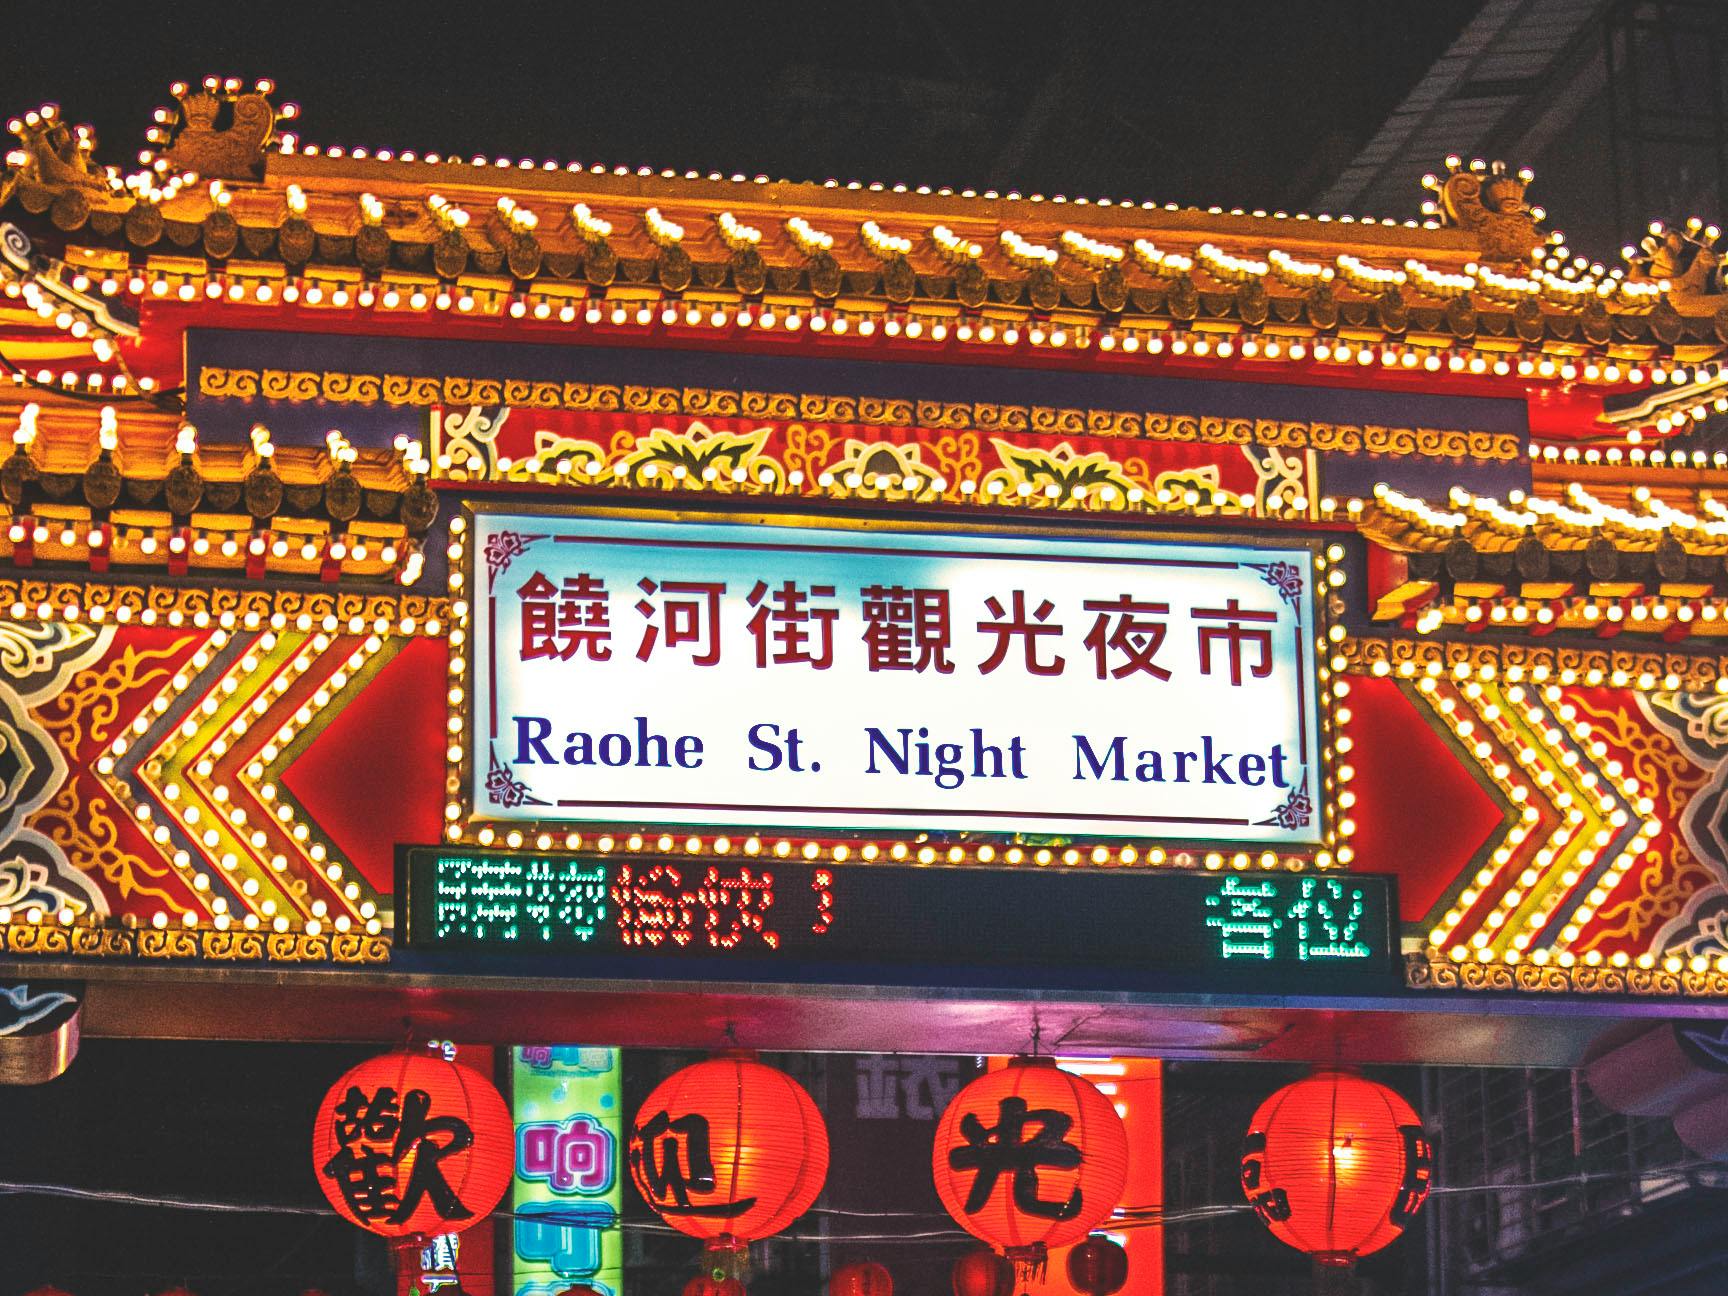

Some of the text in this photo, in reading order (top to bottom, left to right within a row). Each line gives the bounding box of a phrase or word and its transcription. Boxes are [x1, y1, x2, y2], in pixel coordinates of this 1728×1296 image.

[516, 570, 1277, 688] 饒河街觀光夜市
[512, 715, 1290, 790] Raohe St. Night Market
[1204, 876, 1371, 960] 各位
[322, 1085, 475, 1227] 歡
[630, 1110, 758, 1216] 迎
[948, 1096, 1084, 1221] 光
